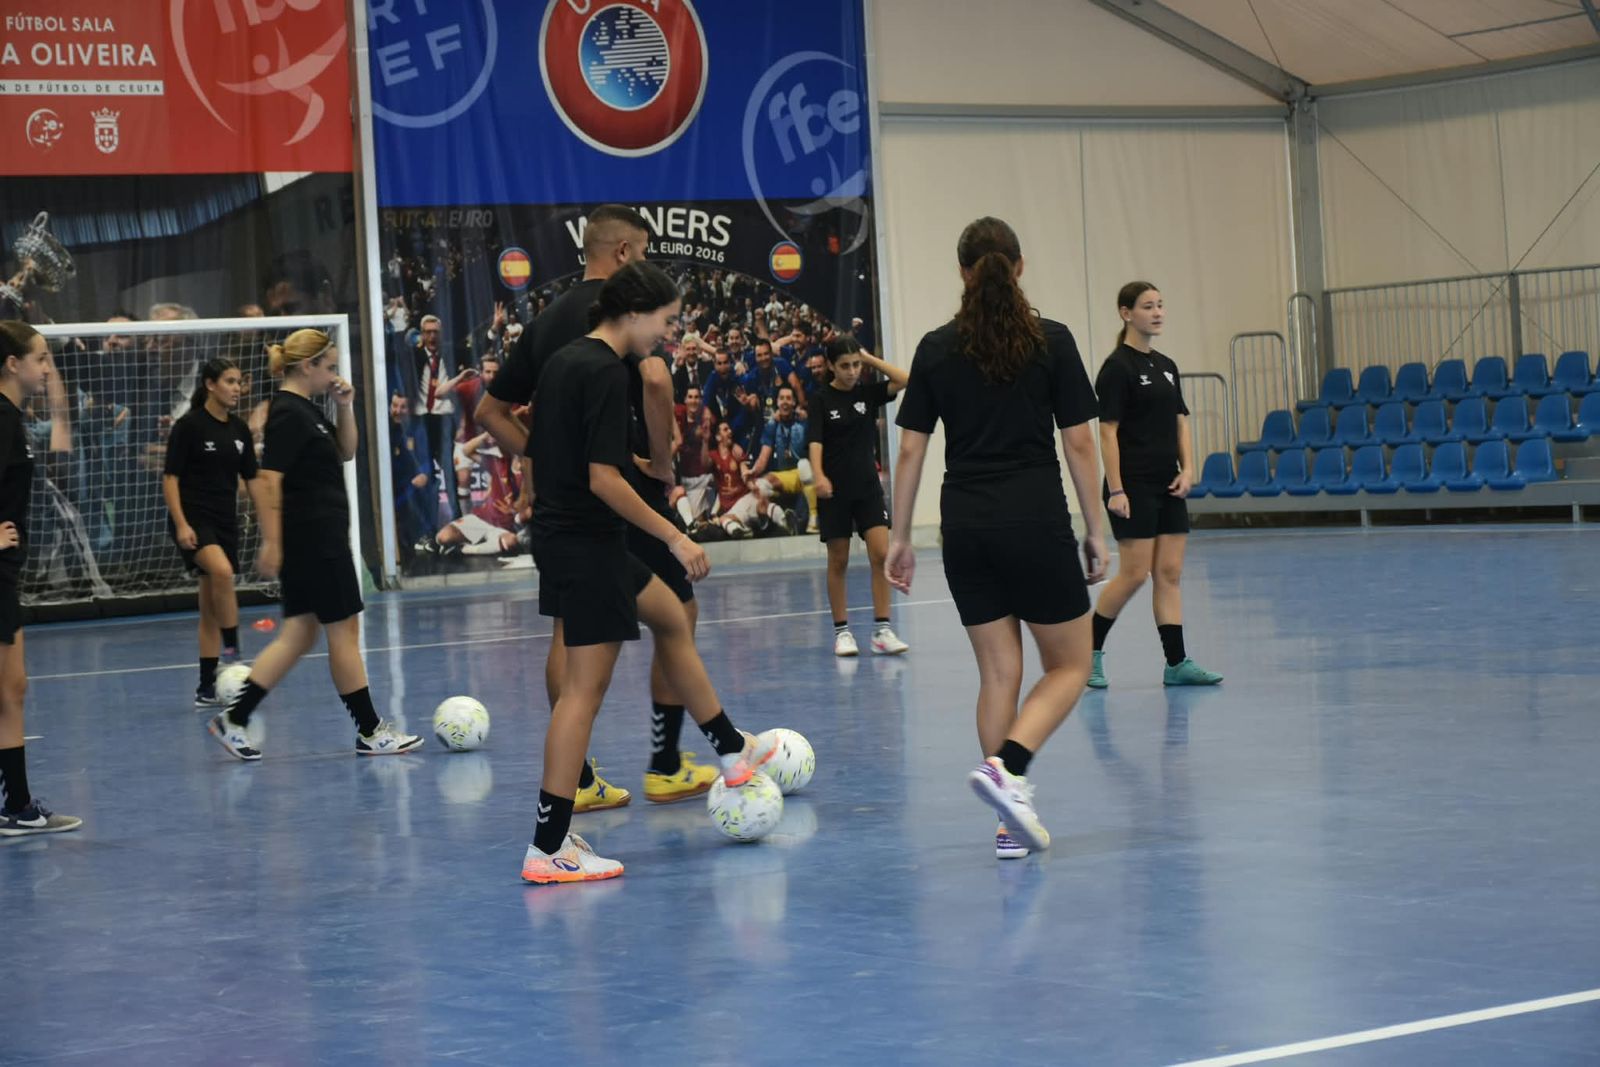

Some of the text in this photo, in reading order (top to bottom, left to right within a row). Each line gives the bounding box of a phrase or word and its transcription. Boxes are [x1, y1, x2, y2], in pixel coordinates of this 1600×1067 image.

[6, 12, 115, 32] FÚTBOL SALA
[31, 42, 157, 66] OLIVEIRA
[15, 84, 30, 92] DE
[39, 82, 87, 93] FÚTBOL
[96, 84, 110, 92] DE
[119, 84, 160, 93] CEUTA
[449, 209, 494, 228] EURO
[565, 206, 732, 247] WNERS
[660, 242, 693, 256] EURO
[695, 247, 725, 263] 2016
